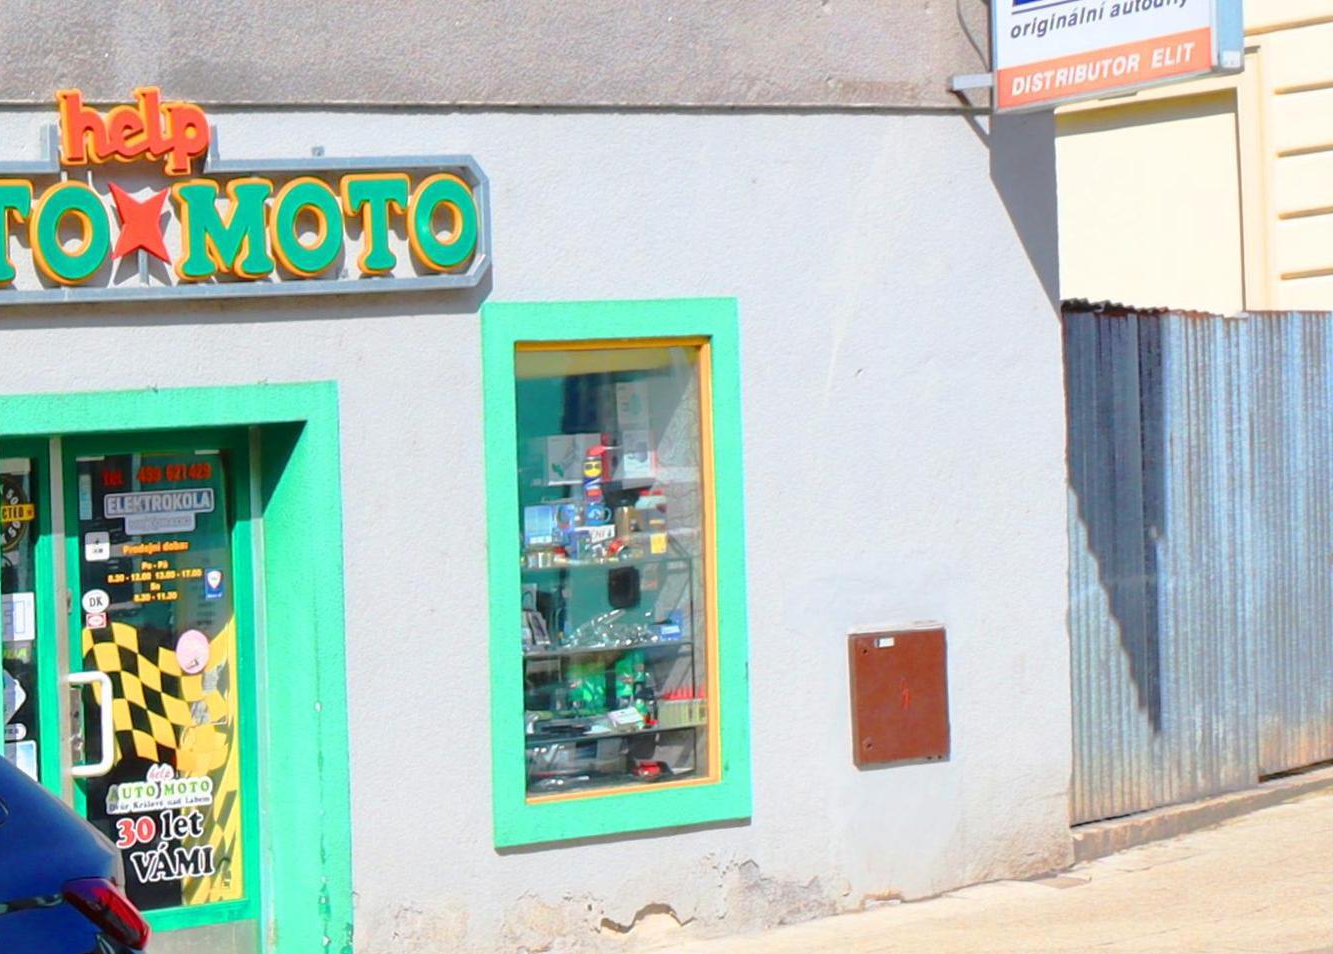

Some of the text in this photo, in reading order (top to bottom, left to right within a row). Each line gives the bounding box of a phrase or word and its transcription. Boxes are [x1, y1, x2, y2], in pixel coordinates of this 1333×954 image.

[1010, 0, 1186, 38] originální auto
[1011, 42, 1196, 97] DISTRIBUTOR ELIT
[56, 86, 210, 176] help
[172, 172, 479, 280] MOTO
[108, 491, 210, 514] ELEKTROKOLA
[89, 596, 103, 608] DK
[109, 780, 210, 801] AUTO MOTO
[116, 811, 203, 848] 30 let
[131, 842, 214, 882] VÁMI
